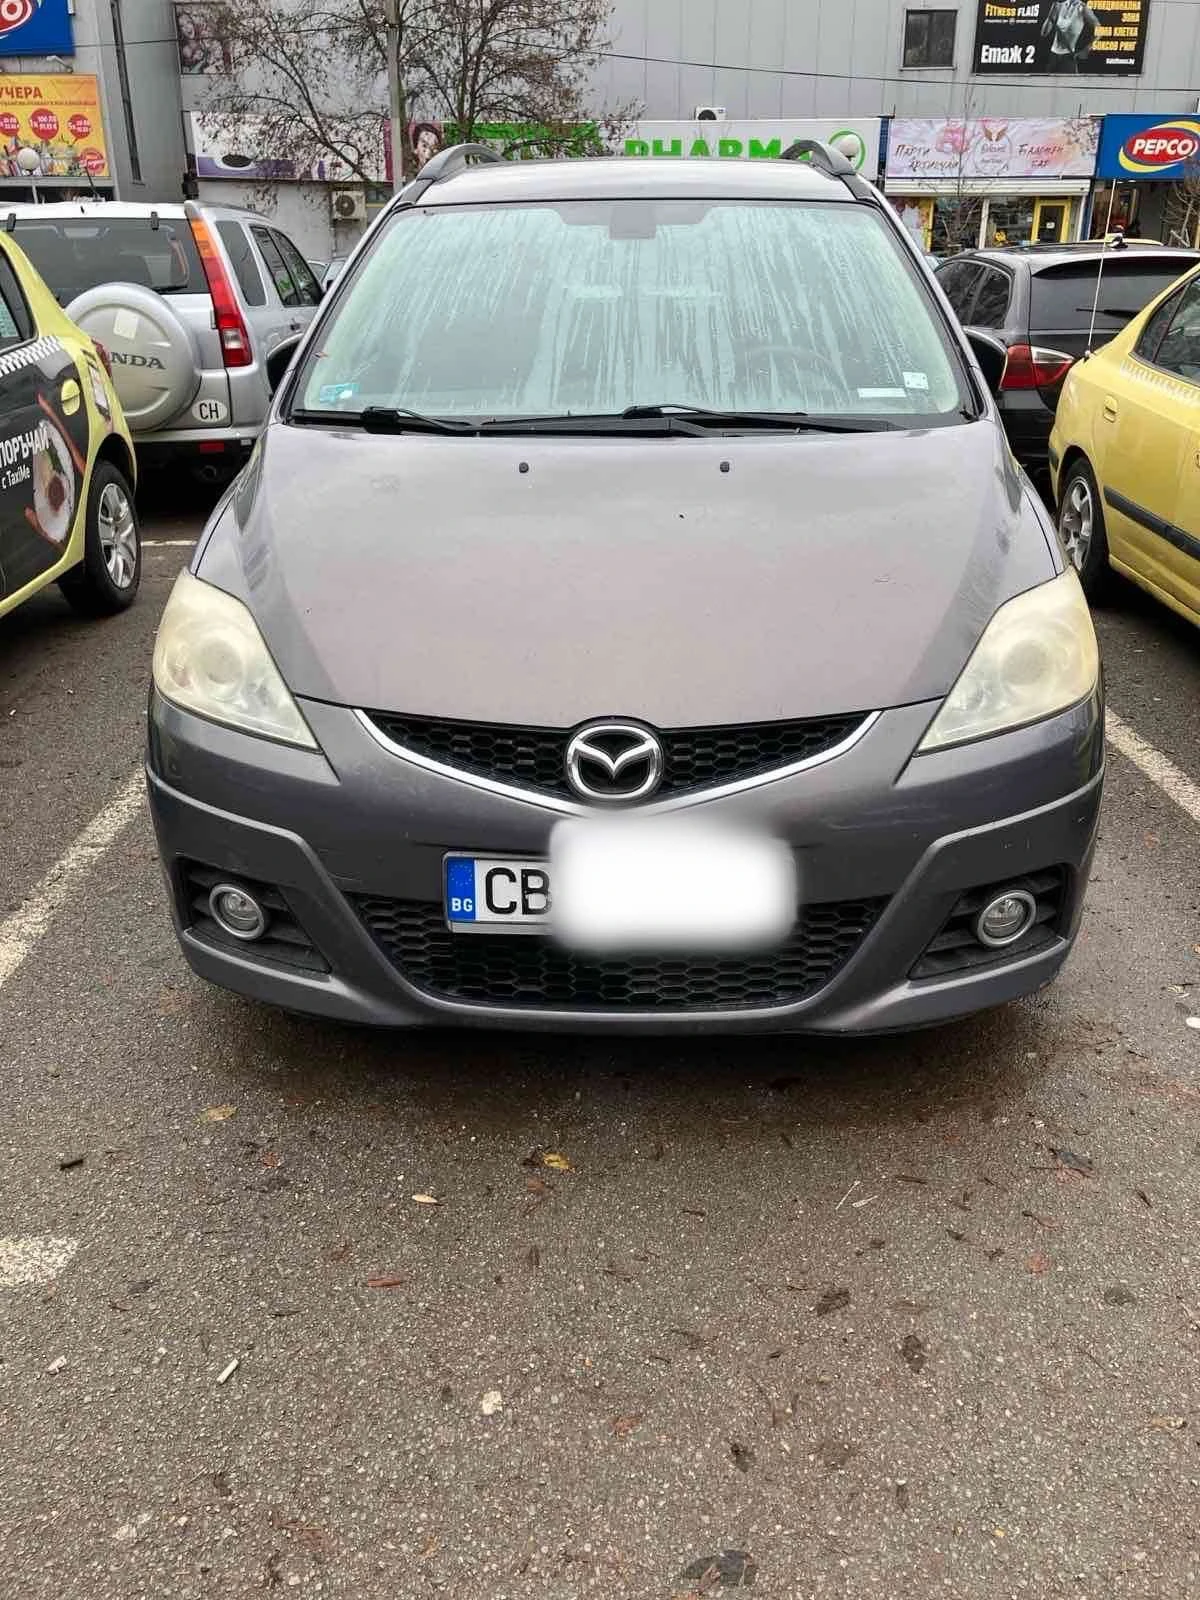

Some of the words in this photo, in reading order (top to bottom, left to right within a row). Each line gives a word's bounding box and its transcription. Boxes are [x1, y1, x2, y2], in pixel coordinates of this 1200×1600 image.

[984, 3, 1017, 17] FITNESS
[1024, 45, 1035, 64] 2
[623, 137, 812, 160] PHARM
[1132, 138, 1193, 155] PEPCO
[111, 351, 166, 370] NDA
[200, 403, 219, 420] CH
[6, 464, 30, 487] TaxiMe
[451, 898, 473, 912] BG
[485, 867, 551, 915] CB
